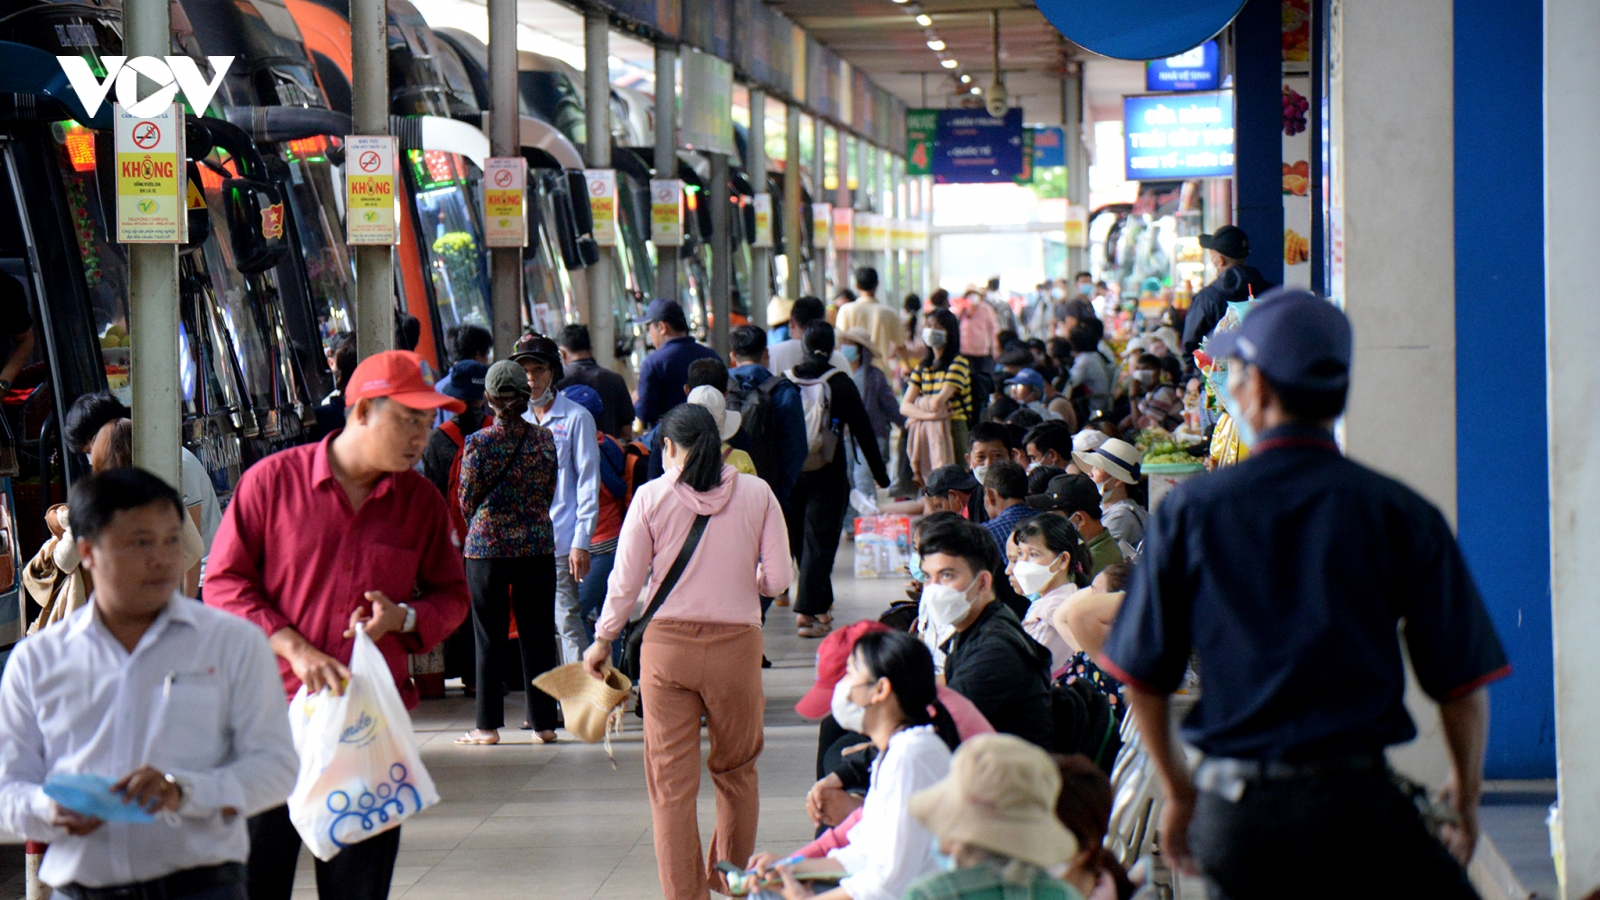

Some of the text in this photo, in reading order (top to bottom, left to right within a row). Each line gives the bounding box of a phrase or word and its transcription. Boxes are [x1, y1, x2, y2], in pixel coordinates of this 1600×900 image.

[122, 154, 173, 180] KHÔNG
[911, 143, 928, 169] 4
[352, 177, 390, 196] KHÔNG
[488, 191, 520, 207] KHÔNG
